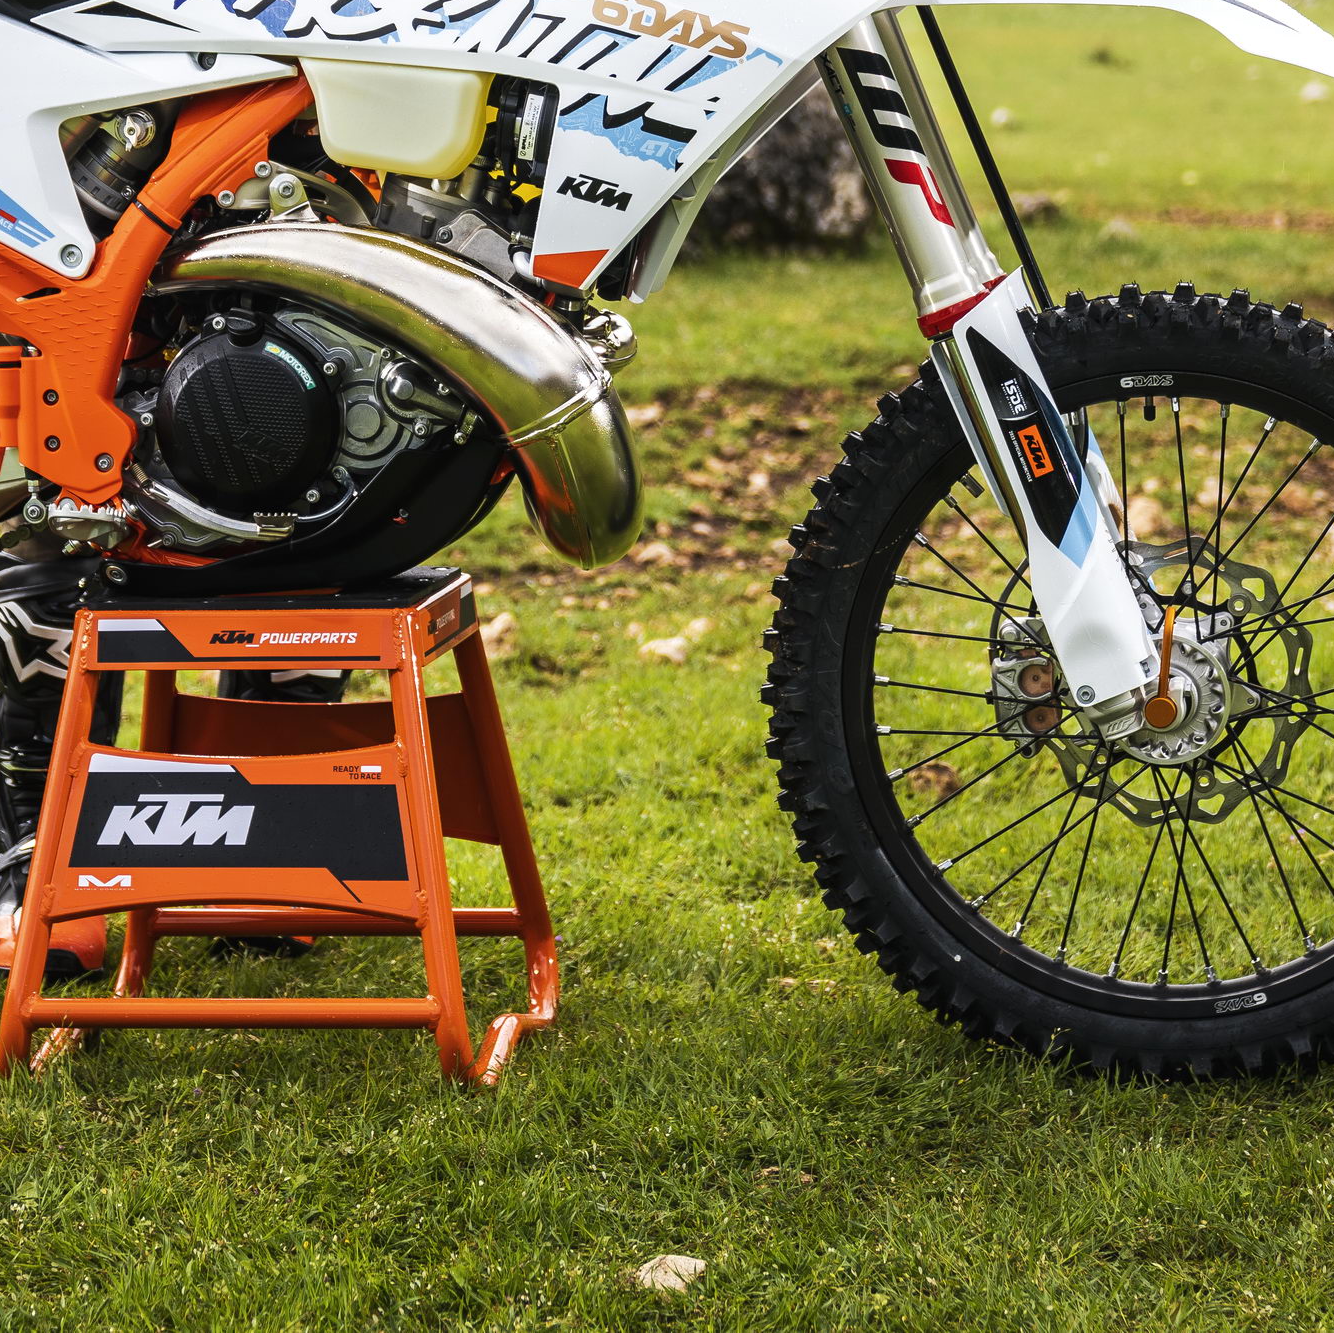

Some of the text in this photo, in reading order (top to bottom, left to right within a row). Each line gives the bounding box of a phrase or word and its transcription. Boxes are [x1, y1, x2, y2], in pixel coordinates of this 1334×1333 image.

[556, 173, 633, 212] KTM
[279, 349, 313, 386] MOTOREX
[1004, 379, 1025, 414] ISDE
[1023, 435, 1046, 470] KTM
[209, 630, 255, 645] KTM
[97, 794, 255, 845] KTM
